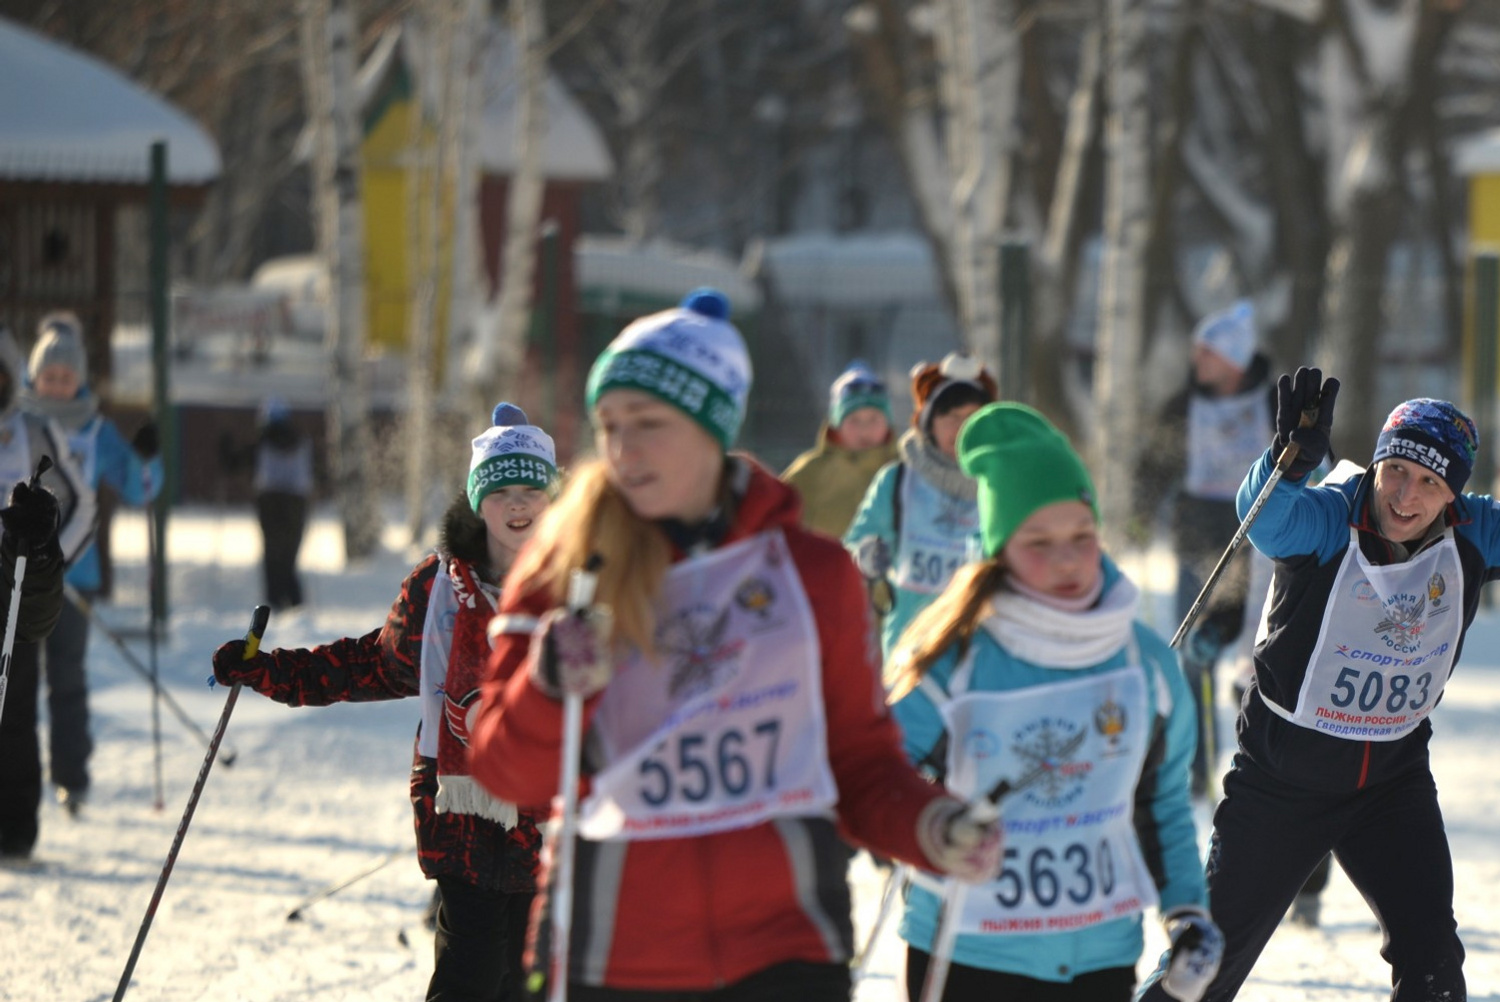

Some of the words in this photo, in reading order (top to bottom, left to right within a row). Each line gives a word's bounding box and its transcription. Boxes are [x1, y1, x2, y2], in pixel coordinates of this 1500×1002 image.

[1385, 445, 1447, 479] RUSSIA
[1330, 666, 1433, 714] 5083
[1315, 707, 1363, 725] ЛЫЖНЯ
[1364, 715, 1407, 726] РОССИИ
[1315, 719, 1392, 737] Свердловская
[637, 718, 783, 806] 5567
[995, 839, 1116, 911] 5630
